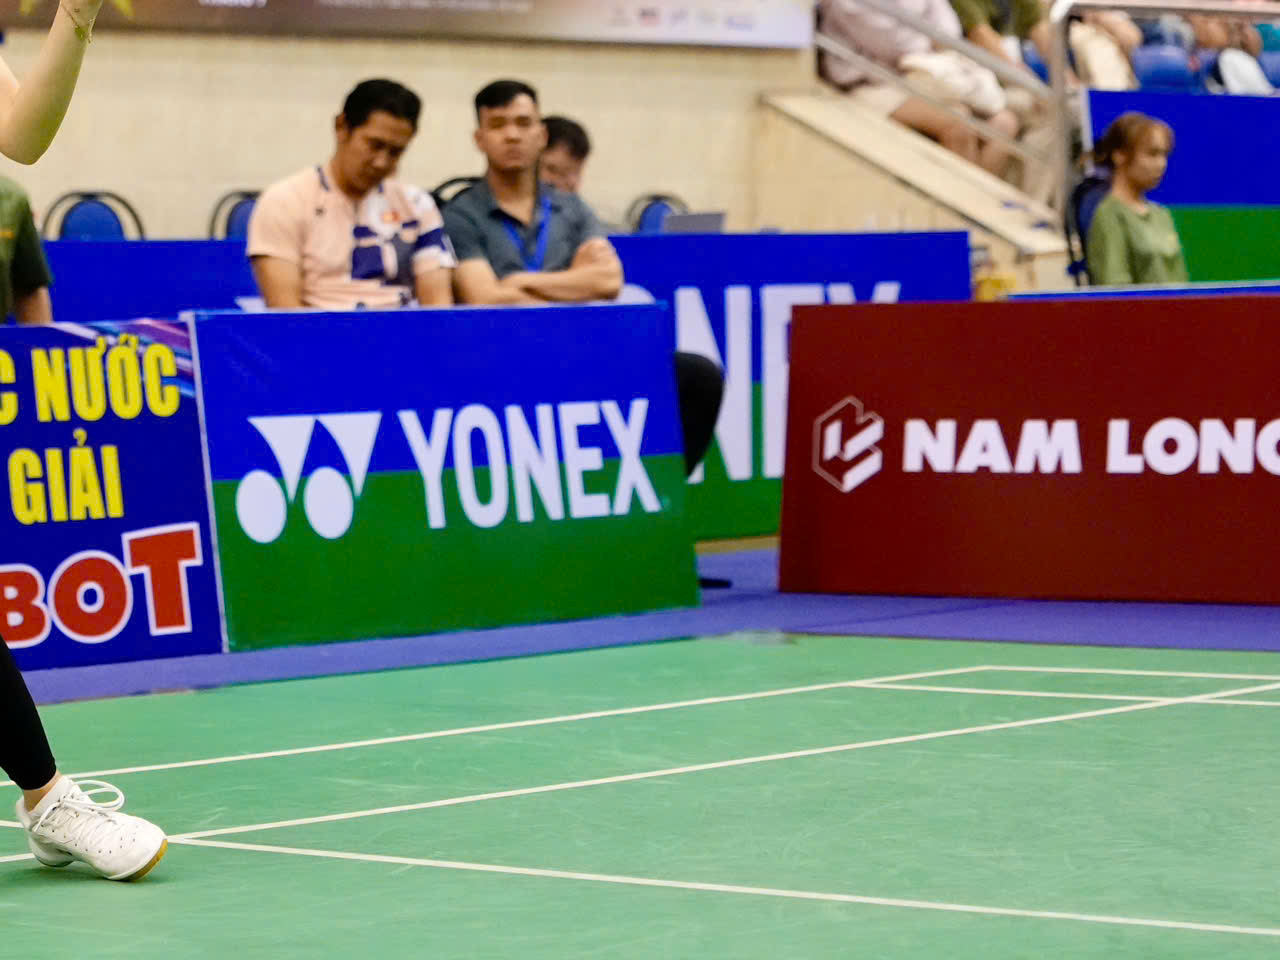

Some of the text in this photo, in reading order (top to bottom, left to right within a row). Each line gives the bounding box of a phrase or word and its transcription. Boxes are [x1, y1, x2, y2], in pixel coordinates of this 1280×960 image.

[31, 333, 181, 423] NƯỚC
[7, 427, 125, 525] GIẢI
[398, 398, 661, 529] YONEX
[902, 418, 1083, 474] NAM
